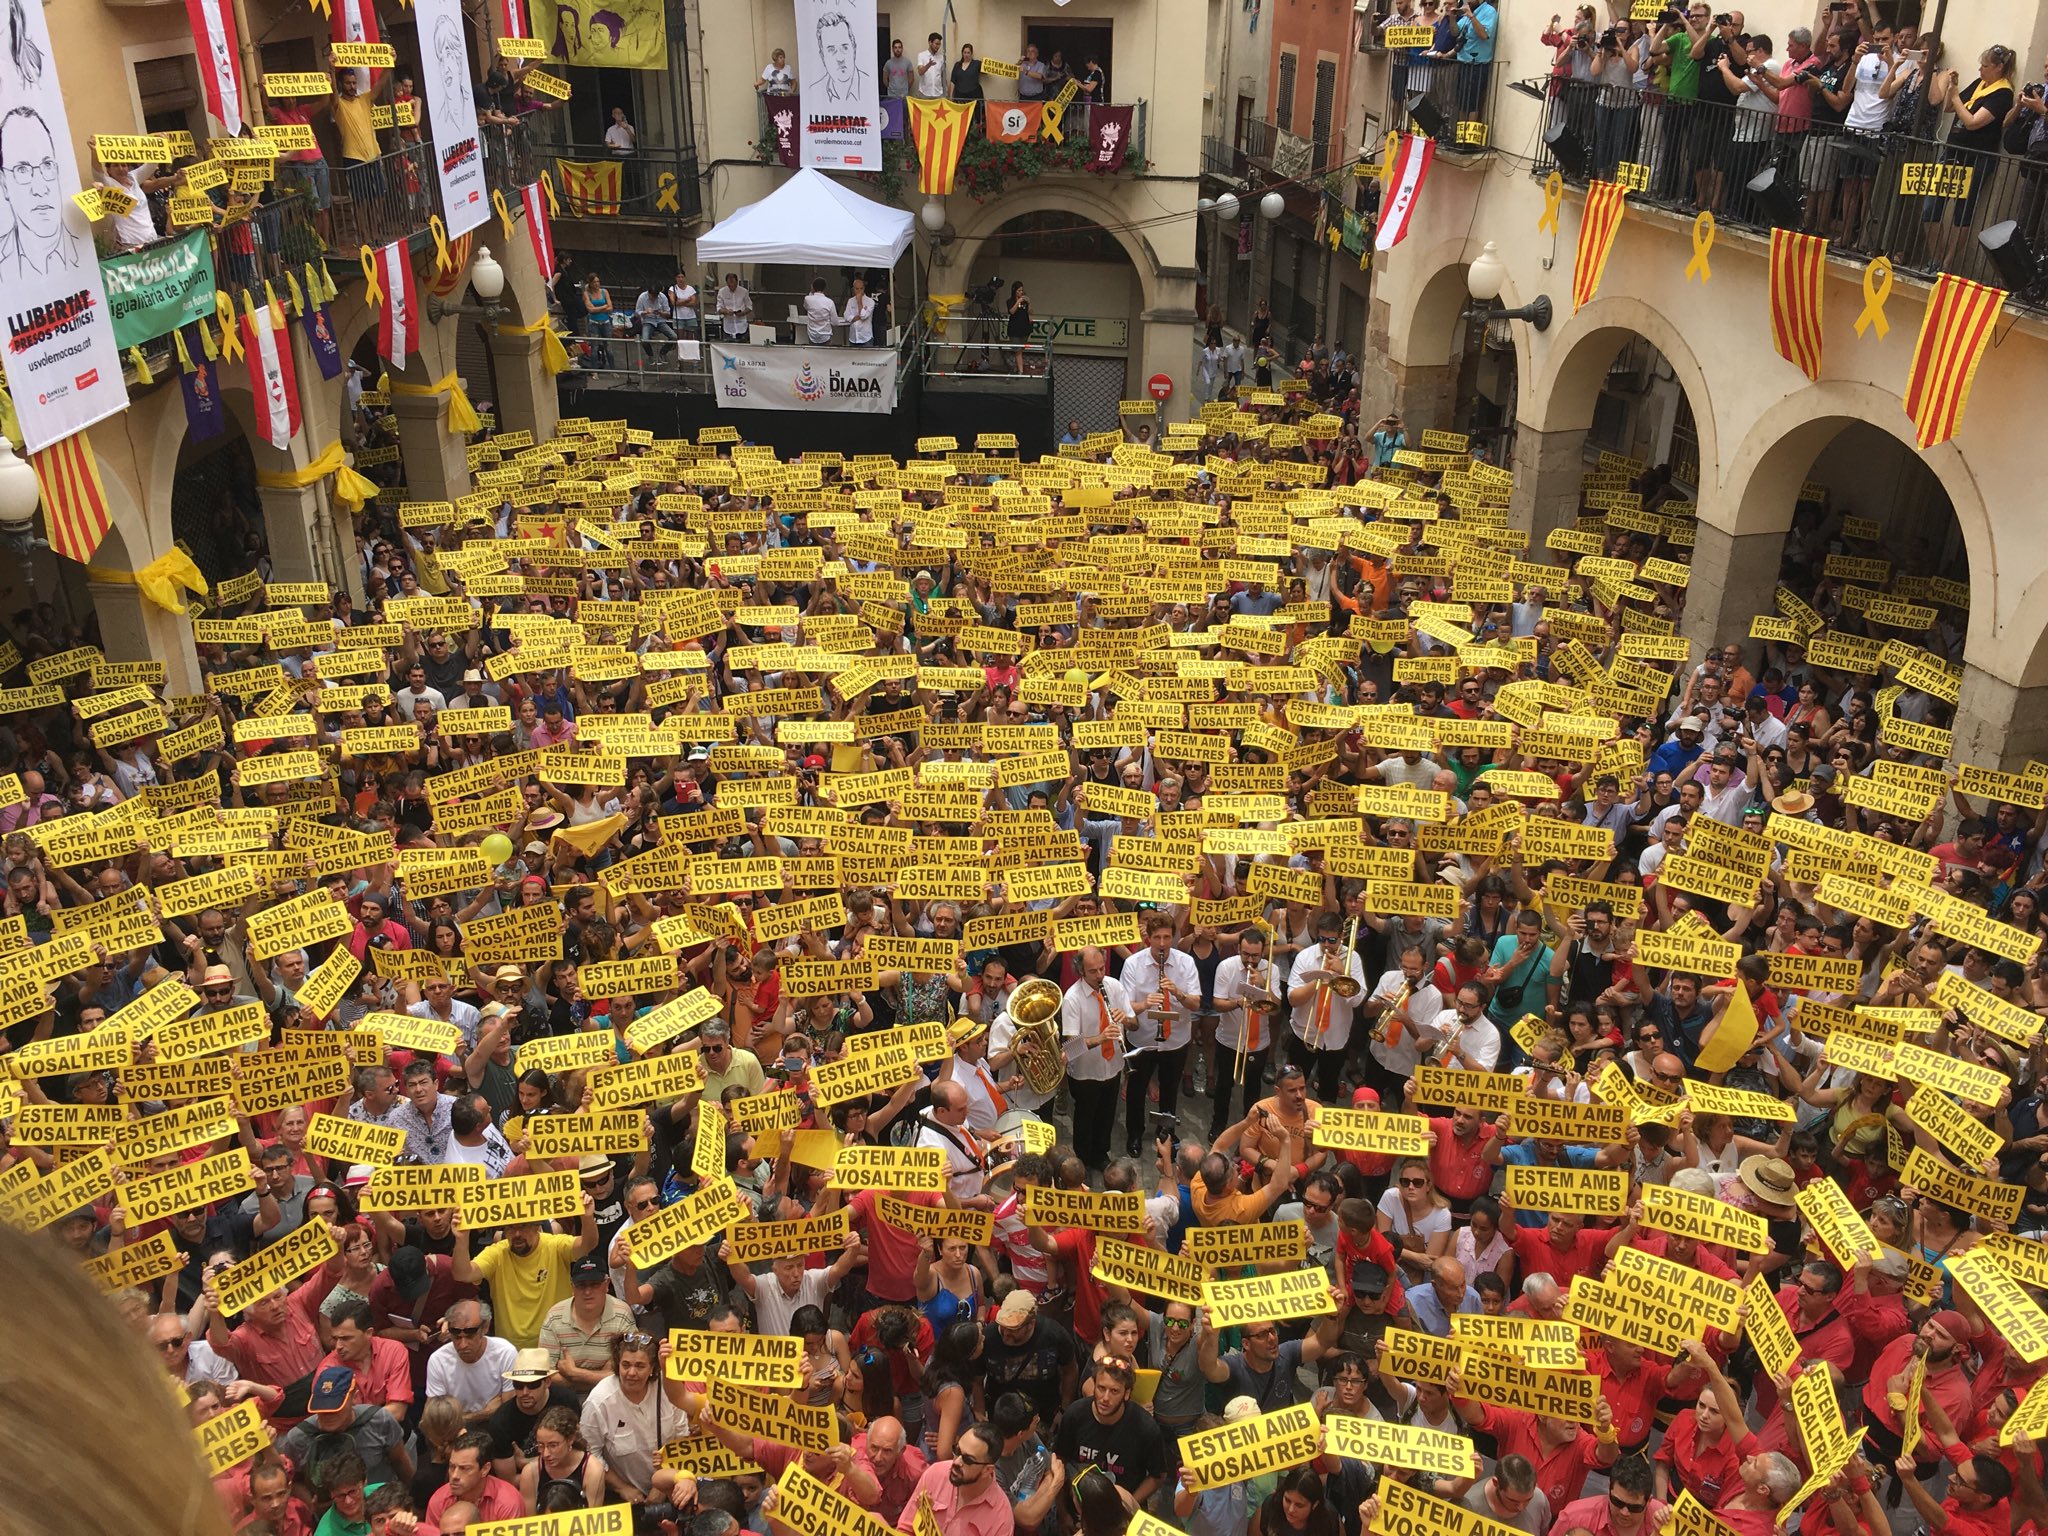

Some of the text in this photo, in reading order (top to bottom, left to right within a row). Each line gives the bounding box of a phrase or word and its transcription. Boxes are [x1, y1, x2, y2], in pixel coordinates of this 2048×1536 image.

[1388, 27, 1431, 36] ESTEM AMB
[1388, 36, 1429, 45] VOSALTRES
[335, 44, 388, 54] ESTEM AMB
[337, 55, 390, 65] VOSALTRES
[266, 74, 324, 84] ESTEM AMB
[269, 84, 327, 94] VOSALTRES
[809, 114, 867, 127] LLIBERTAT
[1008, 115, 1020, 128] Sí
[97, 136, 166, 150] ESTEM AMB
[100, 149, 166, 160] VOSALTRES
[106, 243, 199, 296] REPÚBLICA
[110, 288, 165, 319] igualitària
[164, 283, 180, 299] de
[8, 289, 91, 337] LLIBERTAT
[14, 327, 53, 351] PRESOS
[829, 368, 840, 377] La
[724, 384, 747, 397] tac
[829, 378, 881, 392] DIADA
[760, 560, 814, 569] ESTEM AMB
[760, 570, 814, 578] VOSALTRES
[269, 584, 324, 593] ESTEM AMB
[270, 593, 325, 603] VOSALTRES
[1352, 616, 1405, 630] ESTEM AMB
[1352, 627, 1405, 640] VOSALTRES
[1622, 645, 1684, 658] VOSALTRES
[1623, 634, 1685, 648] ESTEM AMB
[94, 707, 159, 734] ESTEM AMB
[98, 718, 162, 745] VOSALTRES
[345, 727, 414, 741] ESTEM AMB
[346, 738, 414, 752] VOSALTRES
[1159, 732, 1225, 748] ESTEM AMB
[241, 752, 314, 771] ESTEM AMB
[545, 754, 621, 769] ESTEM AMB
[1158, 745, 1224, 760] VOSALTRES
[242, 763, 317, 783] VOSALTRES
[545, 769, 620, 783] VOSALTRES
[1214, 765, 1284, 776] ESTEM AMB
[1962, 766, 2043, 793] ESTEM AMB
[1214, 778, 1283, 789] VOSALTRES
[1961, 778, 2040, 805] VOSALTRES
[903, 792, 977, 805] ESTEM AMB
[1364, 787, 1441, 804] ESTEM AMB
[903, 806, 977, 819] VOSALTRES
[1364, 800, 1440, 818] VOSALTRES
[47, 824, 135, 851] ESTEM AMB
[50, 839, 138, 865] VOSALTRES
[1329, 845, 1409, 863] ESTEM AMB
[694, 859, 777, 876] ESTEM AMB
[1329, 860, 1408, 878] VOSALTRES
[160, 866, 248, 900] ESTEM AMB
[694, 873, 777, 891] VOSALTRES
[1372, 882, 1454, 900] ESTEM AMB
[165, 880, 253, 913] VOSALTRES
[1371, 896, 1453, 915] VOSALTRES
[1641, 932, 1734, 958] ESTEM AMB
[1640, 948, 1732, 974] VOSALTRES
[157, 1006, 259, 1044] ESTEM AMB
[160, 1022, 262, 1060] VOSALTRES
[592, 1054, 692, 1089] ESTEM AMB
[594, 1073, 695, 1107] VOSALTRES
[314, 1116, 398, 1147] ESTEM AMB
[532, 1113, 639, 1135] ESTEM AMB
[1321, 1111, 1421, 1134] ESTEM AMB
[310, 1134, 393, 1165] VOSALTRES
[532, 1132, 639, 1154] VOSALTRES
[1320, 1128, 1420, 1152] VOSALTRES
[836, 1149, 939, 1167] ESTEM AMB
[124, 1153, 241, 1202] ESTEM AMB
[835, 1168, 938, 1187] VOSALTRES
[1513, 1168, 1620, 1191] ESTEM AMB
[129, 1172, 246, 1220] VOSALTRES
[1033, 1188, 1139, 1211] ESTEM AMB
[1513, 1189, 1620, 1212] VOSALTRES
[1032, 1208, 1139, 1229] VOSALTRES
[1649, 1187, 1760, 1230] ESTEM AMB
[734, 1213, 843, 1241] ESTEM AMB
[1647, 1206, 1761, 1249] VOSALTRES
[217, 1221, 326, 1291] VOSALTRES
[734, 1232, 851, 1259] VOSALTRES
[222, 1237, 332, 1309] ESTEM AMB
[1619, 1250, 1737, 1305] ESTEM AMB
[1210, 1271, 1321, 1301] ESTEM AMB
[1616, 1269, 1730, 1325] VOSALTRES
[1215, 1291, 1327, 1321] VOSALTRES
[1750, 1279, 1795, 1358] ESTEM AMB
[675, 1333, 797, 1358] ESTEM AMB
[675, 1356, 794, 1383] VOSALTRES
[712, 1380, 830, 1428] ESTEM AMB
[708, 1403, 829, 1451] VOSALTRES
[1187, 1409, 1310, 1461] ESTEM AMB
[1335, 1418, 1464, 1451] ESTEM AMB
[1194, 1433, 1316, 1485] VOSALTRES
[1335, 1434, 1464, 1471] VOSALTRES
